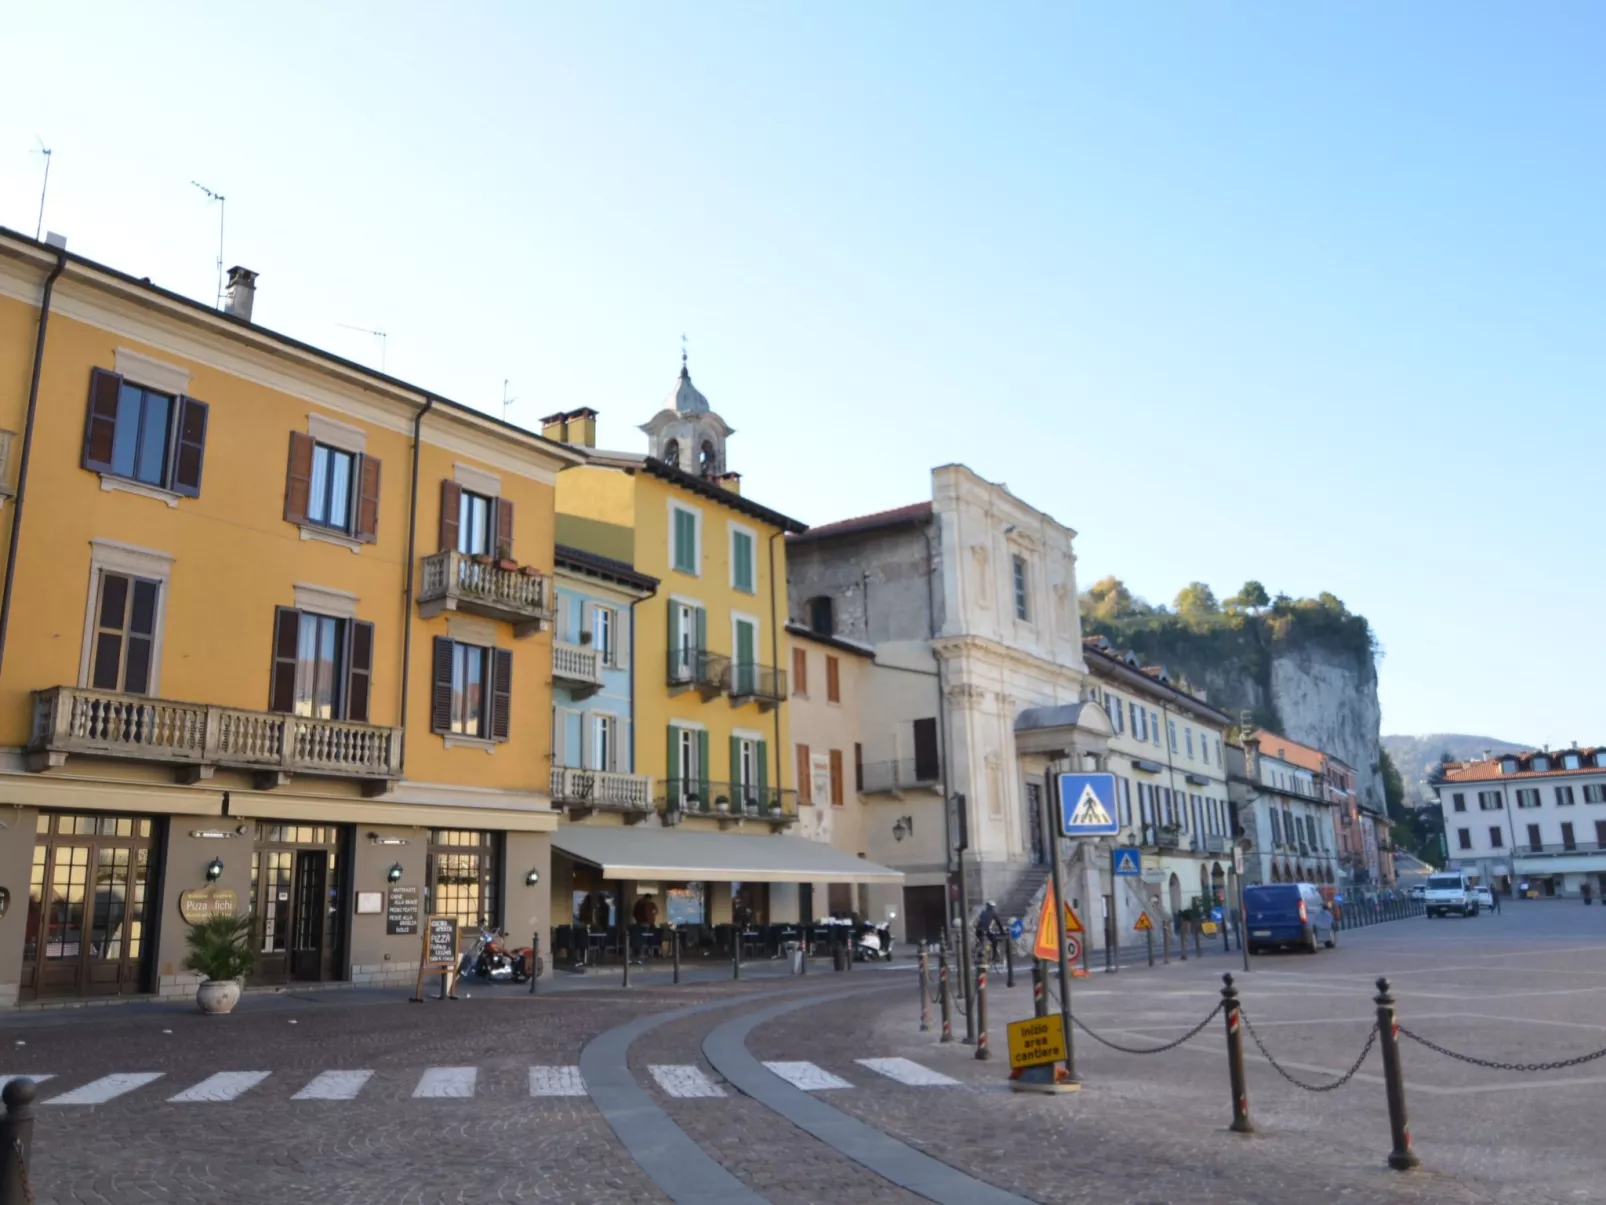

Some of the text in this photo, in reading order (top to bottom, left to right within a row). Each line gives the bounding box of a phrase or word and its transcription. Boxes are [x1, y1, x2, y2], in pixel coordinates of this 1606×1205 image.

[186, 900, 208, 910] Pizza
[431, 934, 451, 943] PIZZA
[1024, 1036, 1048, 1048] area
[1015, 1047, 1060, 1062] cantiere
